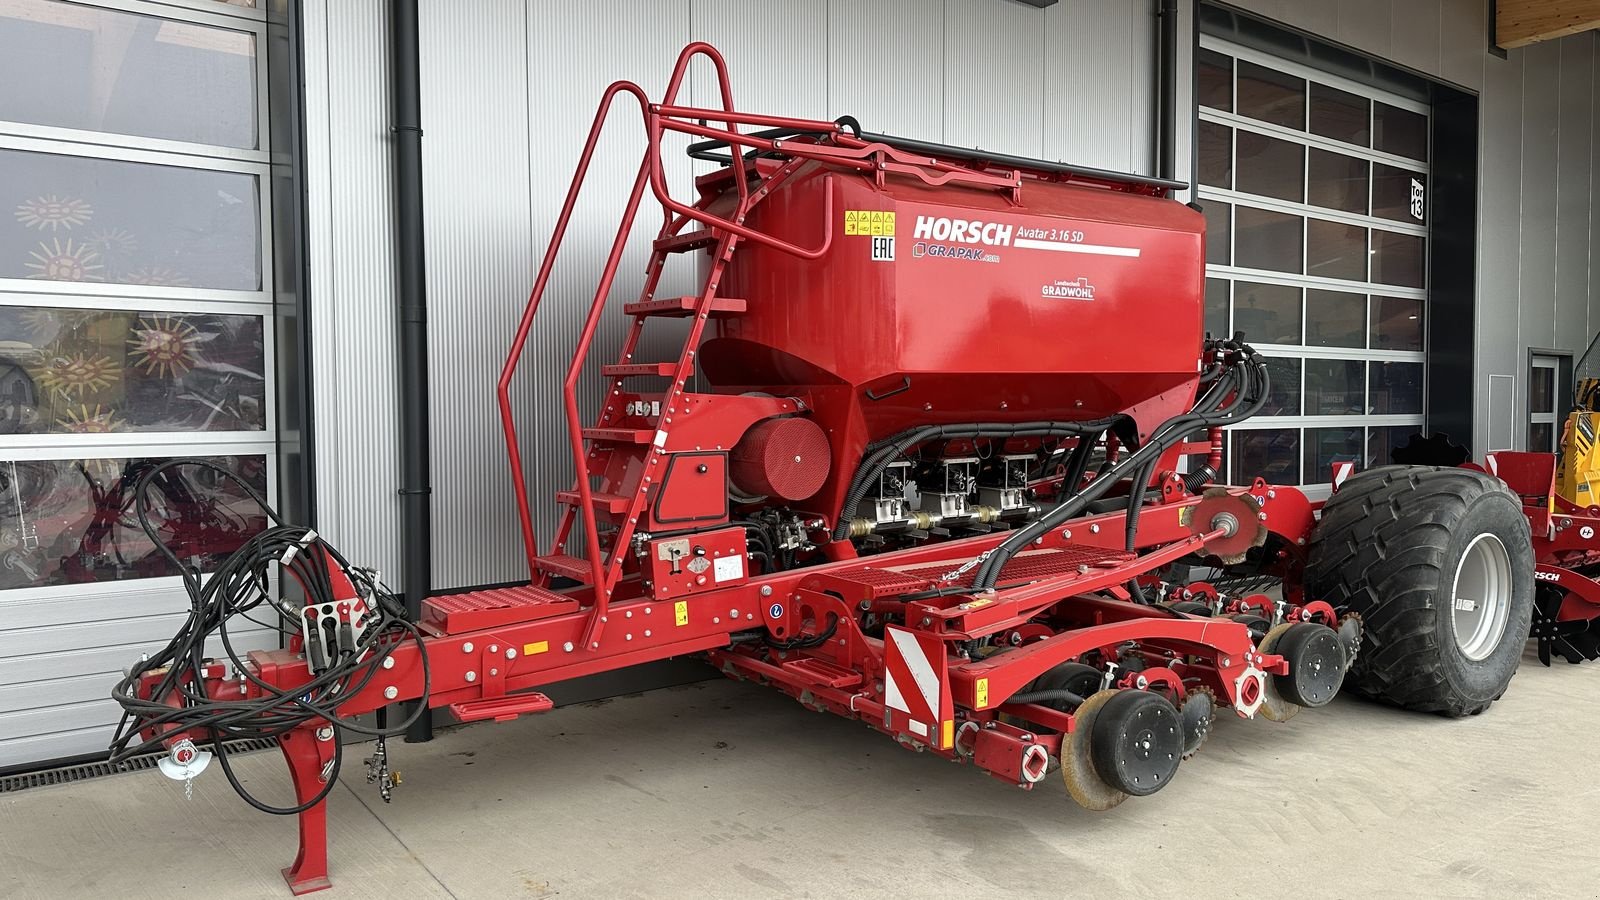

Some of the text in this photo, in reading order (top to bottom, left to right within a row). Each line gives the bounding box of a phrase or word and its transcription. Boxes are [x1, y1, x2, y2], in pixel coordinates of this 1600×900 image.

[1411, 186, 1423, 197] Tor
[1411, 198, 1423, 216] 13
[913, 215, 1084, 246] HORSCH Avatar 3.16 SD
[873, 237, 894, 258] EAC
[1041, 285, 1093, 298] GRADWOHL
